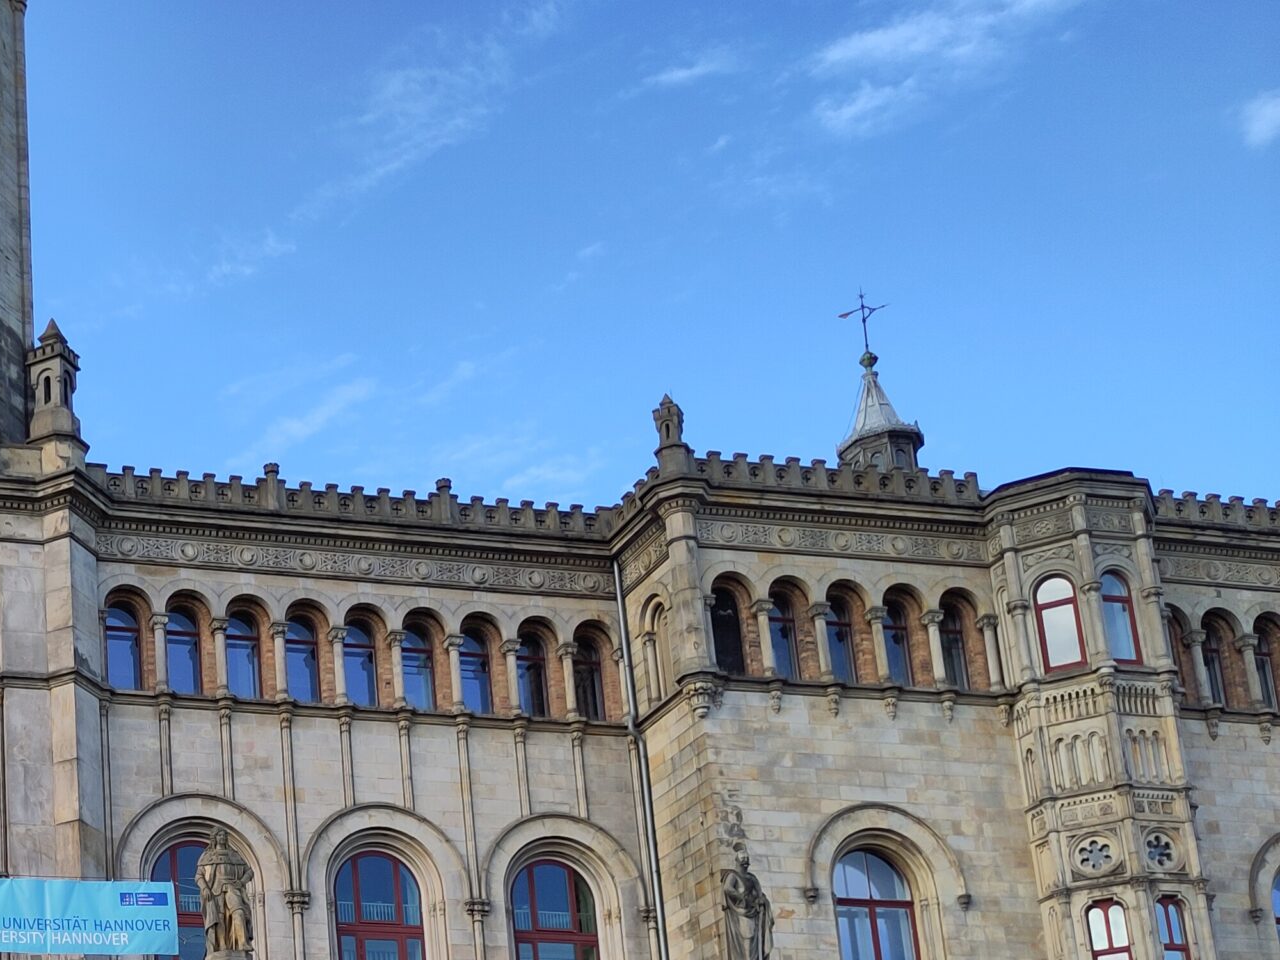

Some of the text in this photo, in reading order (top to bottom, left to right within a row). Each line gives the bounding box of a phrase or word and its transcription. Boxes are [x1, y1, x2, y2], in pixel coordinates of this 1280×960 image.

[2, 915, 88, 931] UNIVERSITÄT
[94, 918, 171, 932] HANNOVER
[51, 931, 129, 946] HANNOVER
